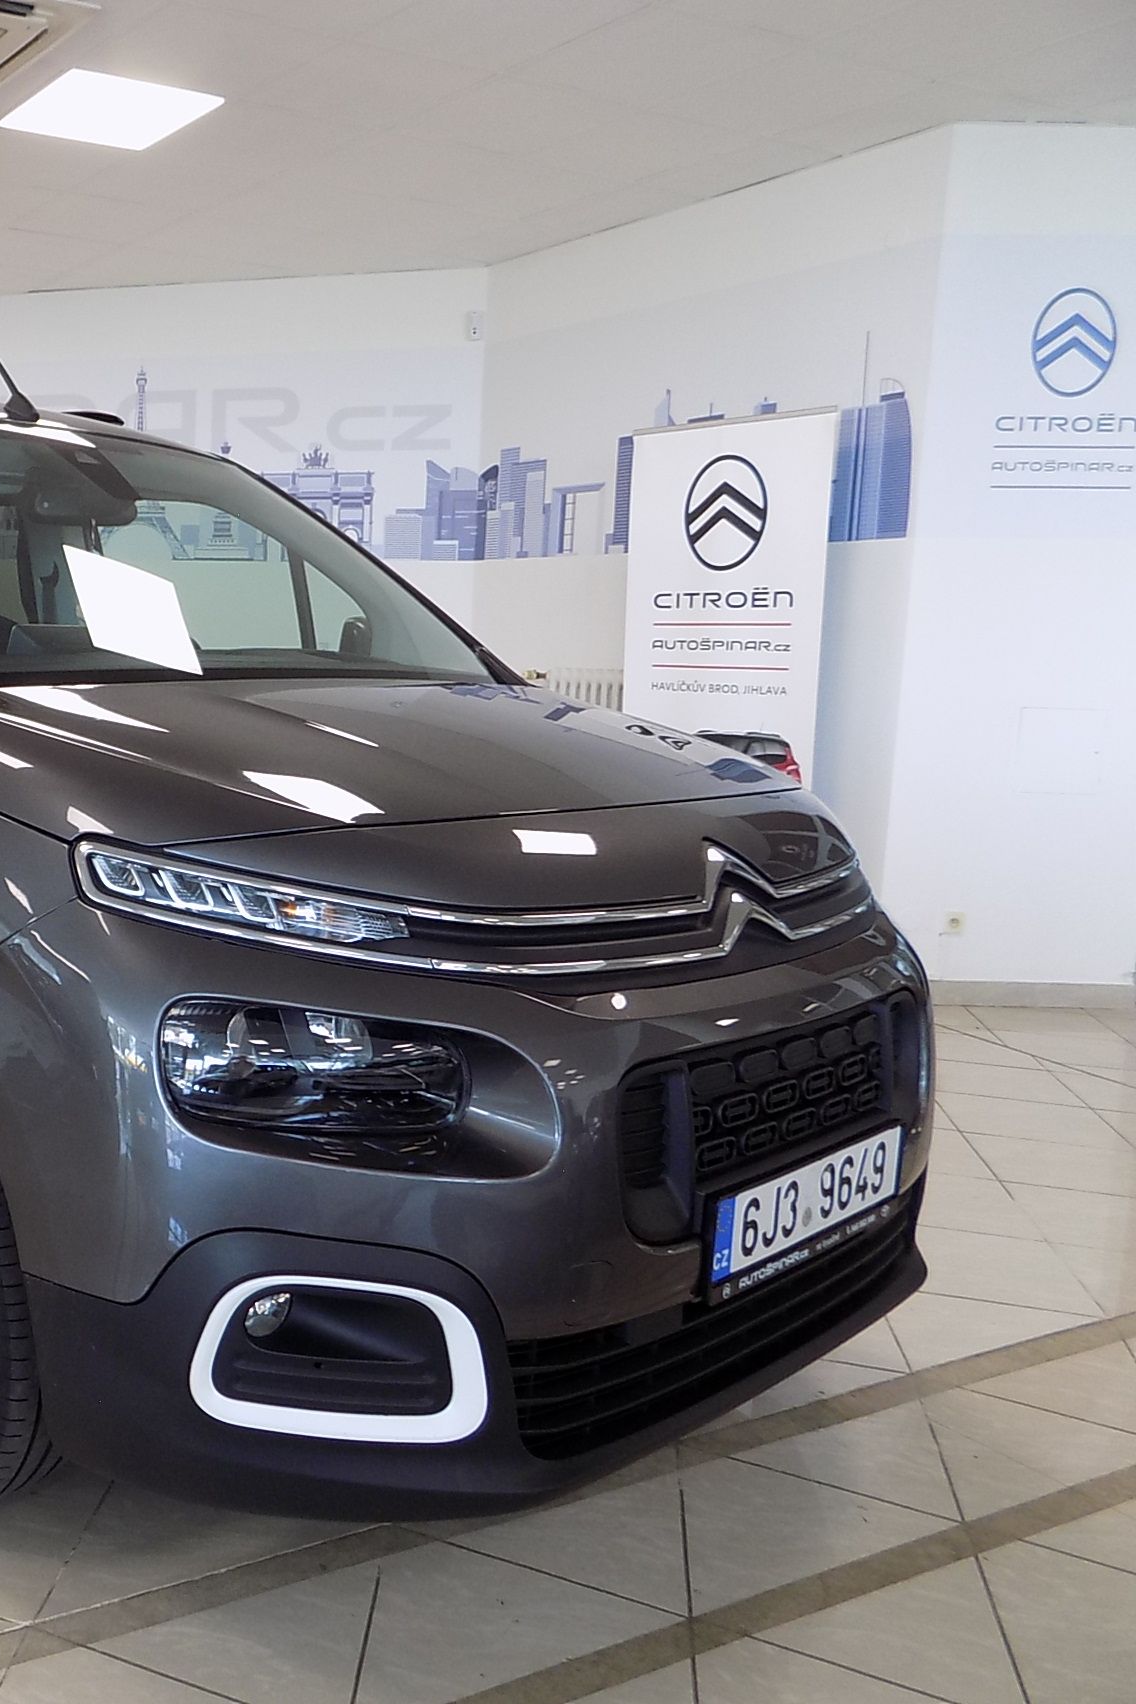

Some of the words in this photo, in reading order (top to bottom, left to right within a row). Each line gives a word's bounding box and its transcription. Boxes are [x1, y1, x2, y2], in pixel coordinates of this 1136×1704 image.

[995, 413, 1136, 433] CITROËN
[653, 586, 794, 609] CITROËN
[651, 680, 706, 693] HAVLÍČKŮV
[743, 686, 787, 696] JIHLAVA
[740, 1180, 800, 1258] 6J3
[820, 1141, 887, 1219] 9649
[713, 1248, 730, 1271] CZ
